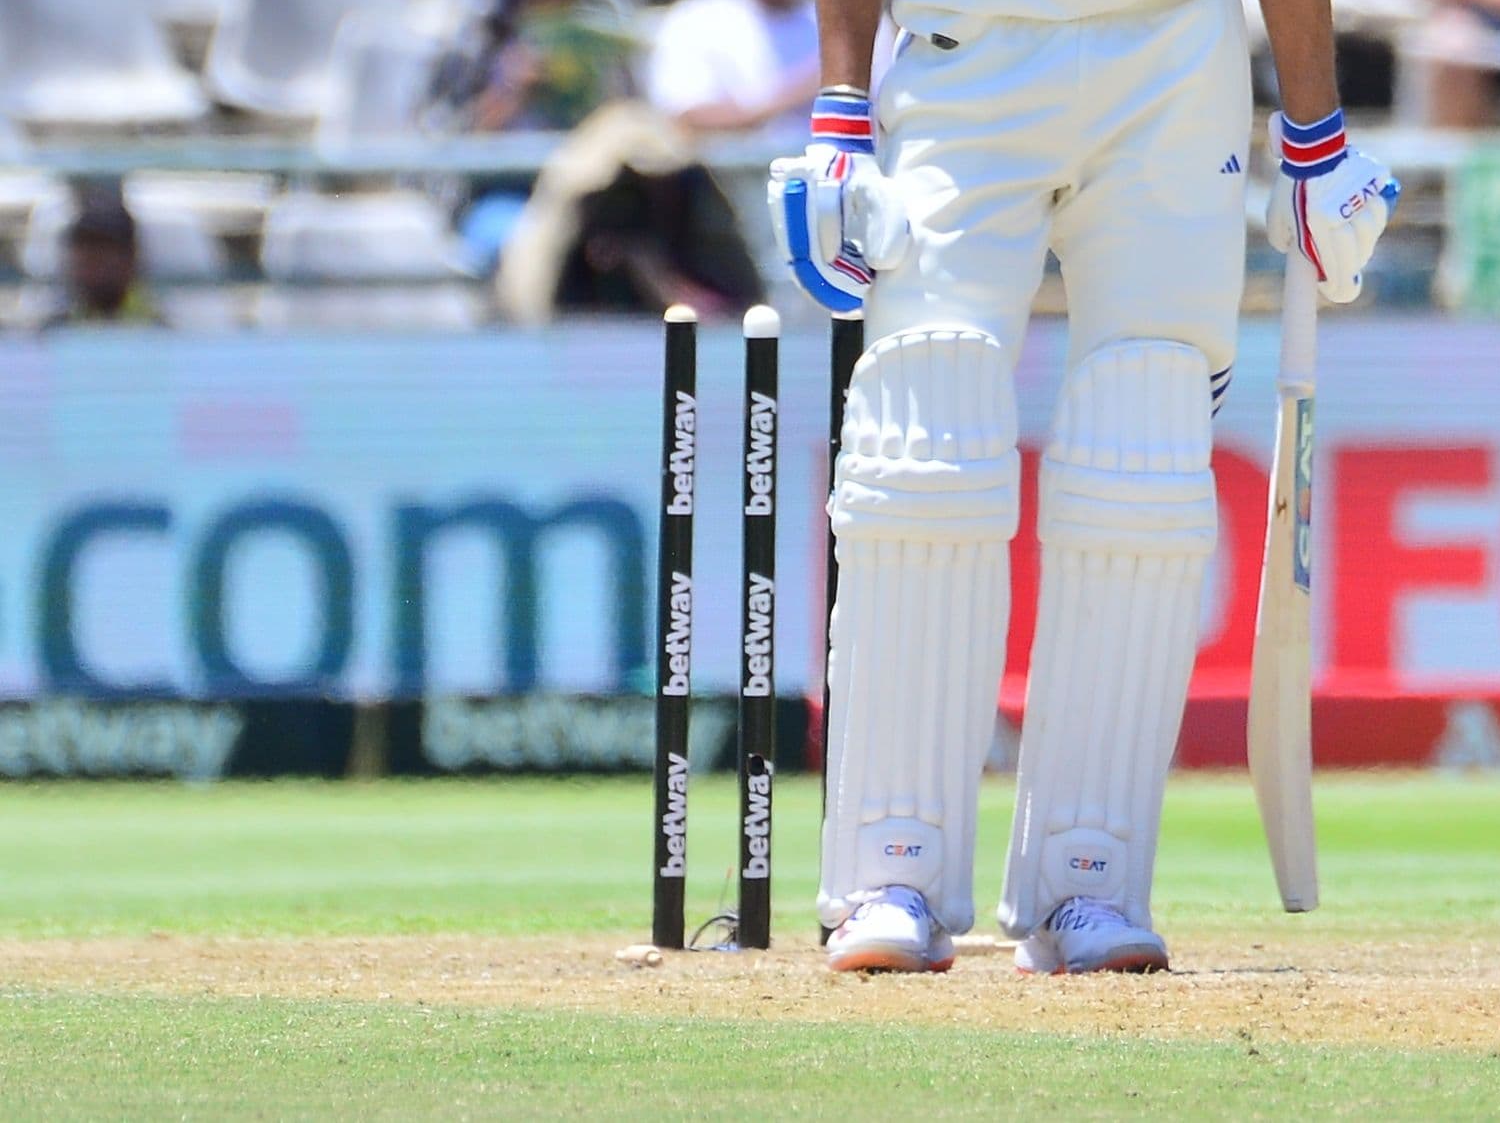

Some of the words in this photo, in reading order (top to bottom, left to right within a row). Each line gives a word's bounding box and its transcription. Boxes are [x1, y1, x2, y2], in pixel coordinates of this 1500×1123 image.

[1339, 178, 1381, 219] CEAT
[667, 390, 696, 516] betway
[744, 391, 777, 516] betway
[662, 571, 692, 696] betway
[743, 572, 775, 697] betway
[660, 751, 689, 878] betway
[884, 844, 922, 857] CEAT
[1069, 858, 1107, 872] CEAT
